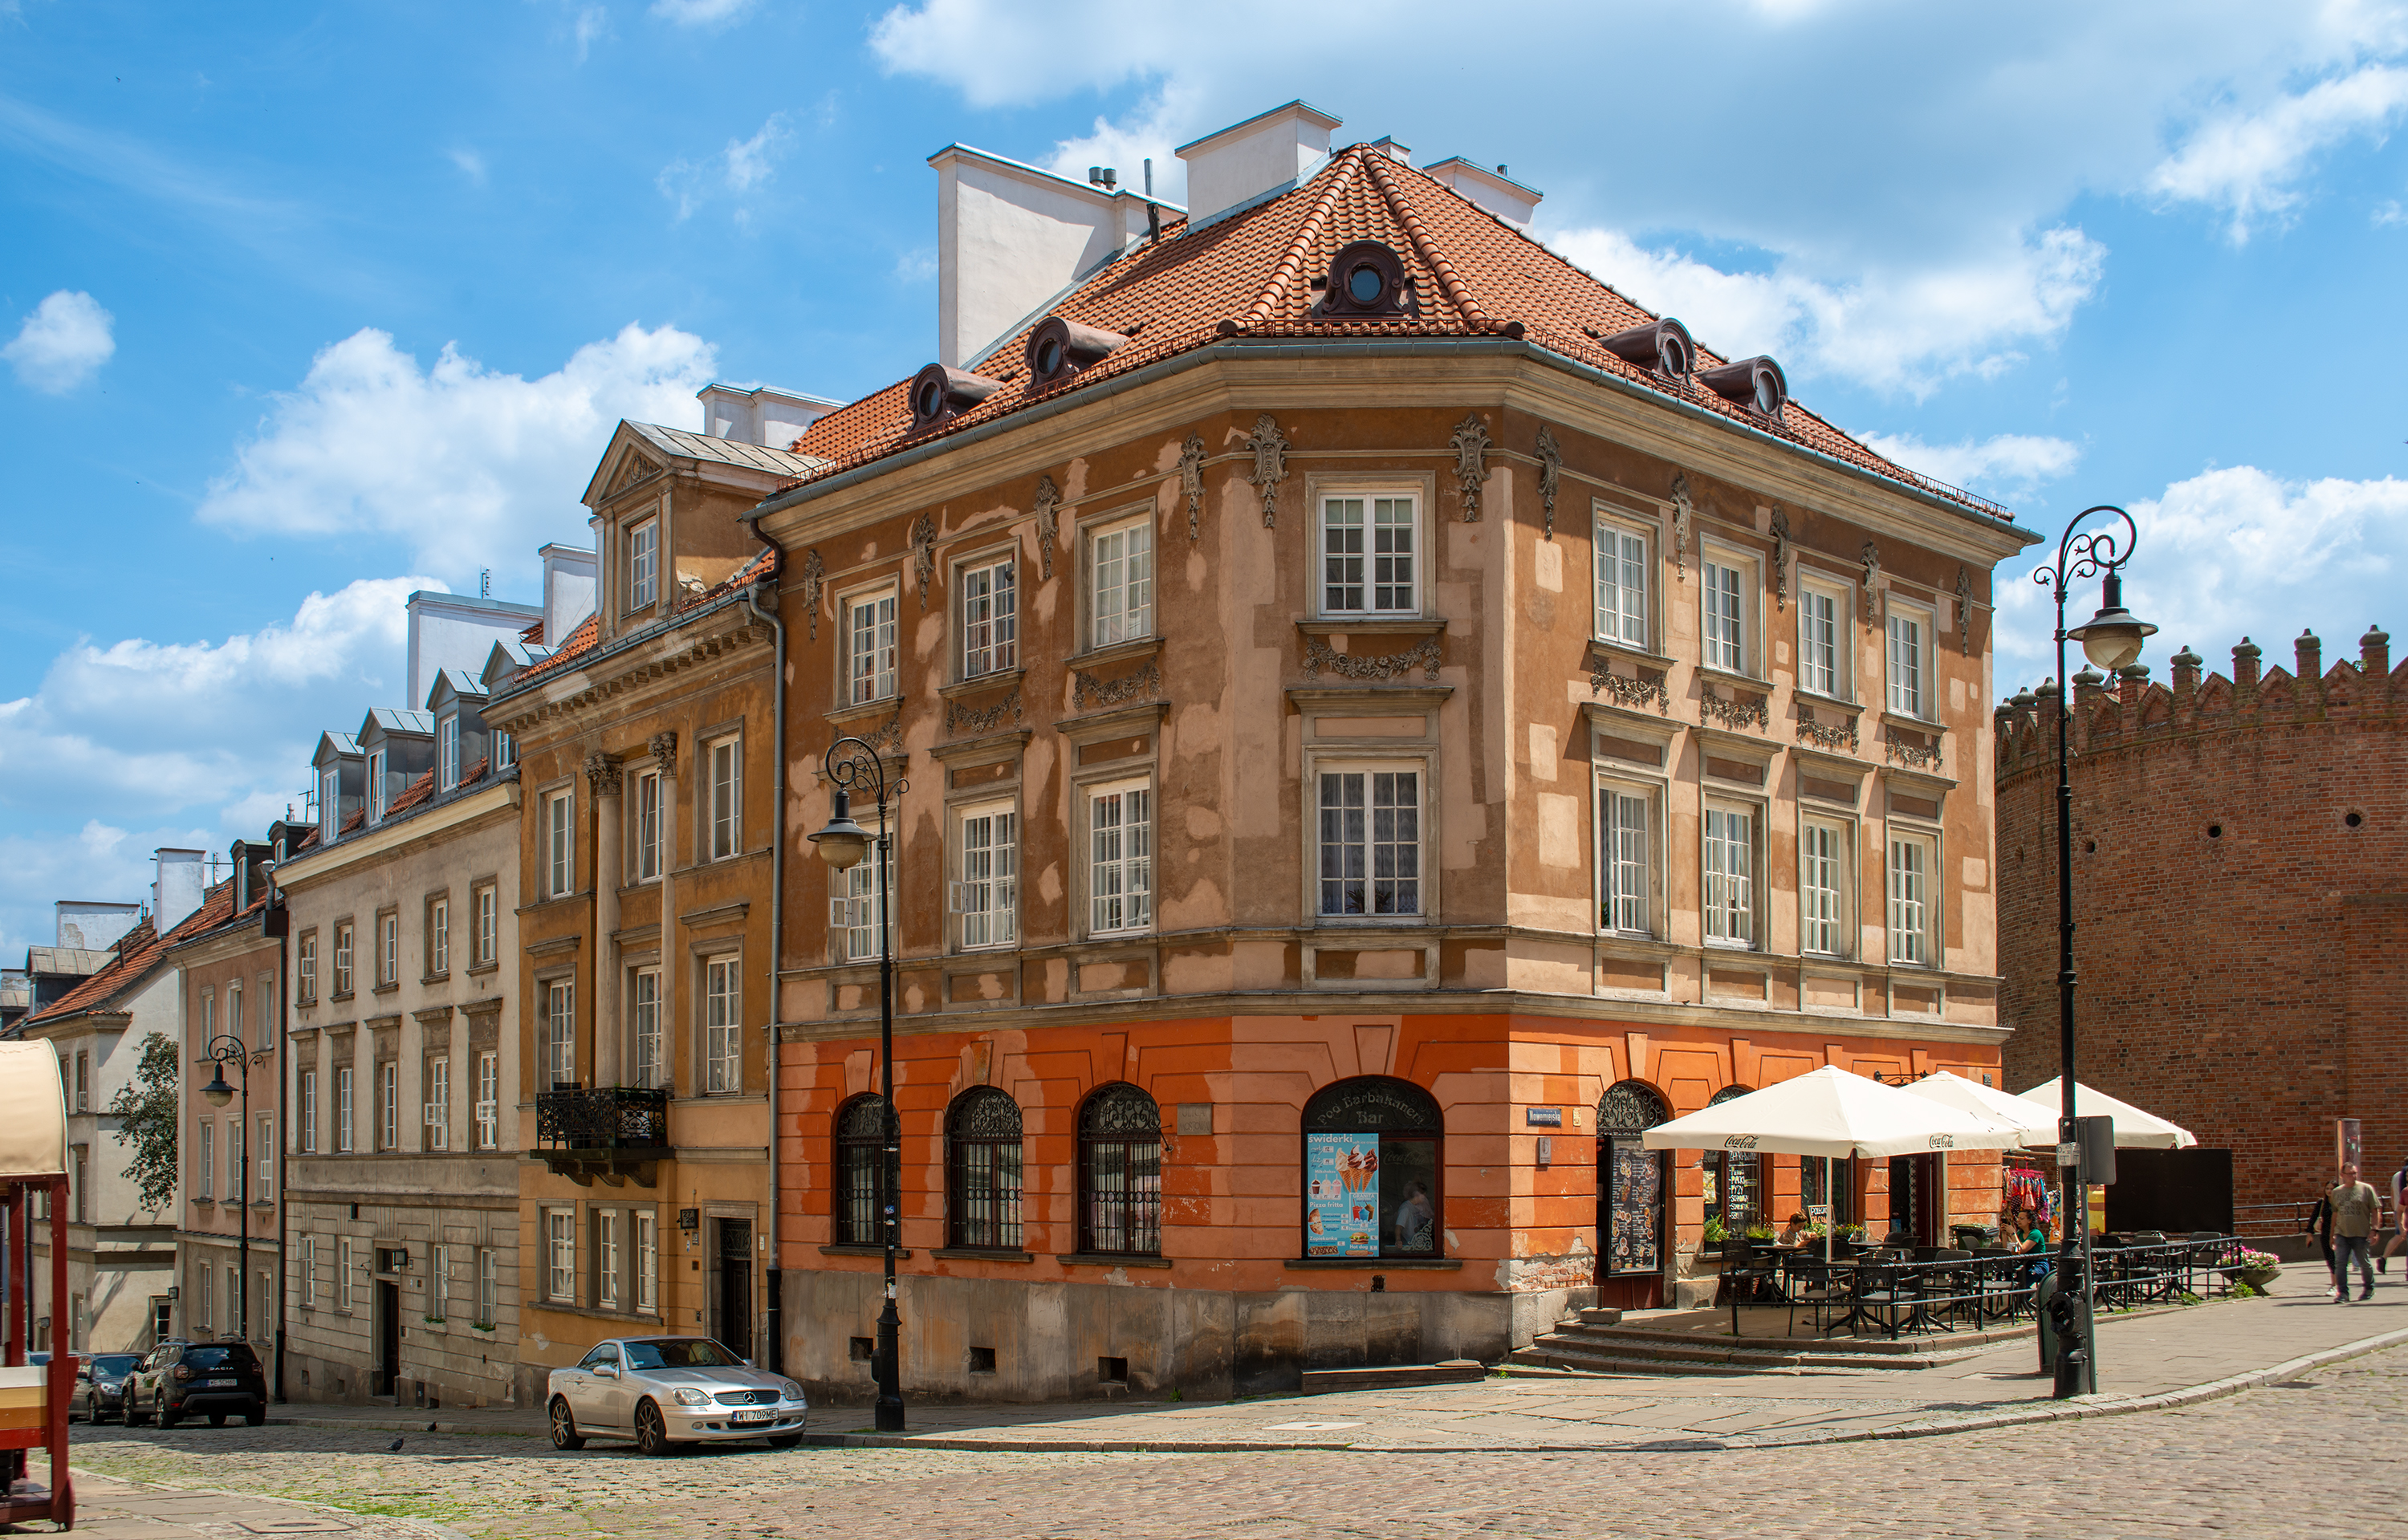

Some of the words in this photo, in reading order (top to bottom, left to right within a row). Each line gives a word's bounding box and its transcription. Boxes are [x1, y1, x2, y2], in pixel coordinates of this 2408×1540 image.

[1357, 1111, 1384, 1124] Bar
[1308, 1133, 1352, 1143] świderki
[751, 1410, 776, 1420] 709ME
